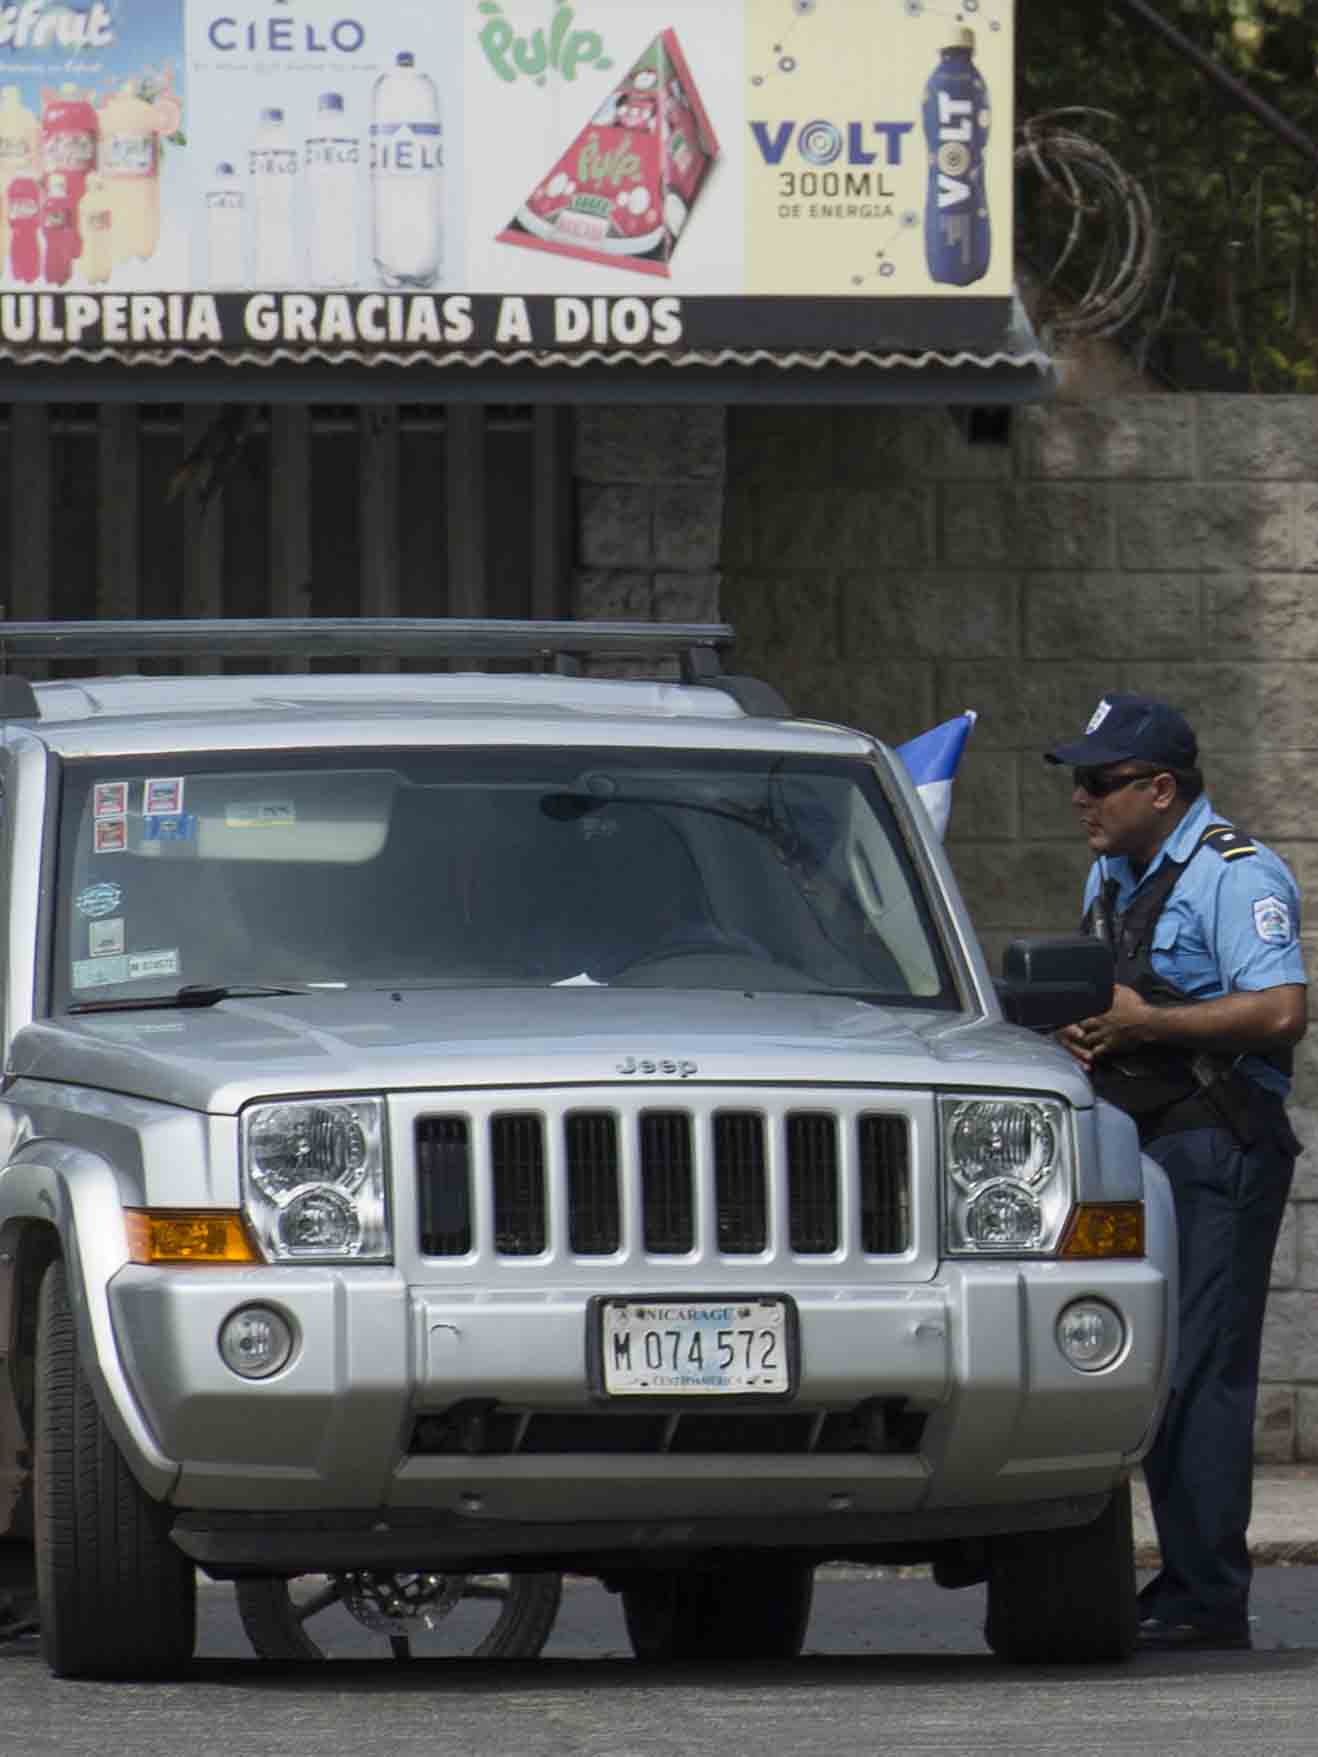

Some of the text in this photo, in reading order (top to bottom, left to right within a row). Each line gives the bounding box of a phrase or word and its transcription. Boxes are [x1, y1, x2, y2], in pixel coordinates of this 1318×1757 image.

[208, 17, 365, 52] CIELO
[478, 0, 606, 83] Pulp
[749, 120, 915, 166] VOLT
[936, 90, 973, 208] VOLT
[779, 172, 895, 197] 300ML
[778, 204, 894, 219] DE ENERGIA
[1, 293, 683, 344] ULPERIA GRACIAS A DIOS
[615, 1055, 700, 1078] Jeep
[645, 1307, 750, 1321] NICARAGU
[613, 1330, 777, 1371] M 074 572
